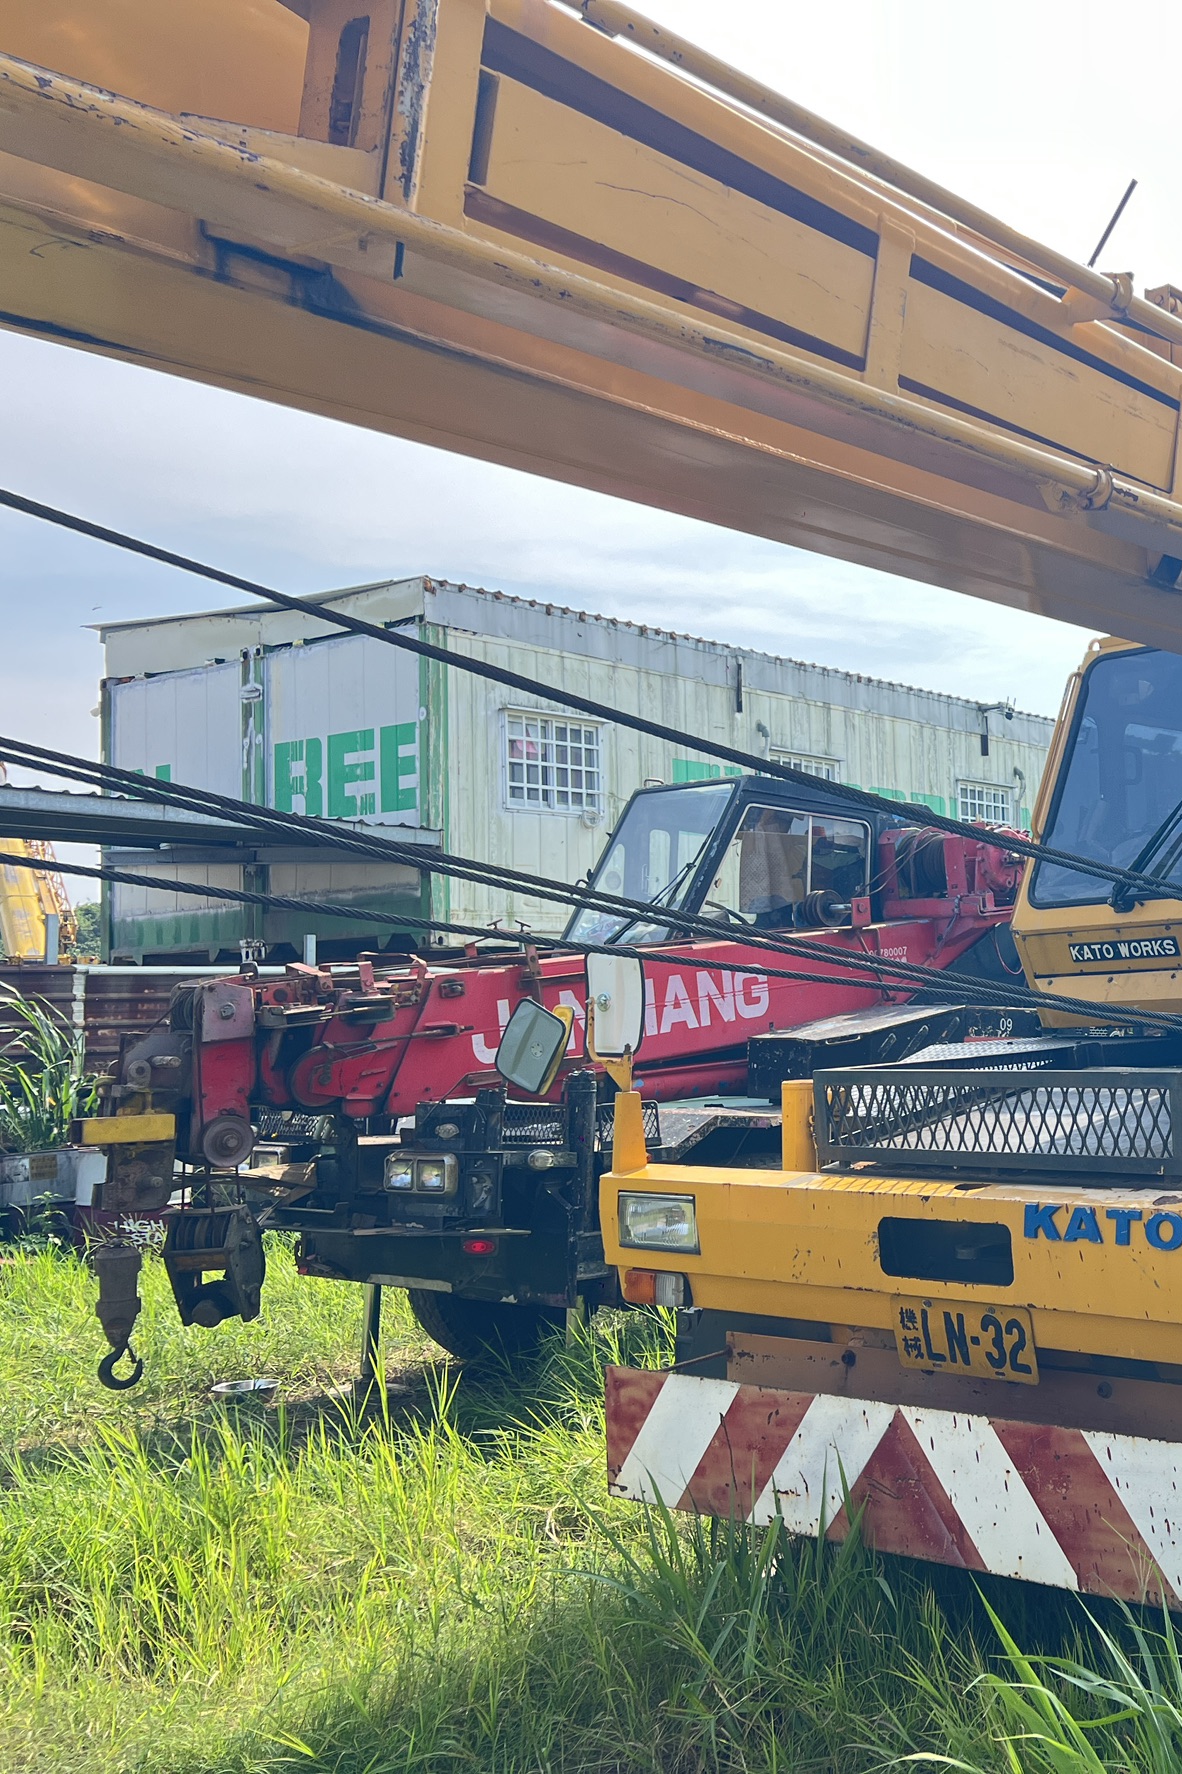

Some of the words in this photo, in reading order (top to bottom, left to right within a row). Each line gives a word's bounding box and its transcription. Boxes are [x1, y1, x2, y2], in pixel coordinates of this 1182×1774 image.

[1069, 944, 1114, 961] KATO
[1117, 938, 1176, 958] WORKS
[999, 1018, 1013, 1032] 09
[899, 1306, 925, 1360] 機械
[921, 1308, 1033, 1375] LN-32
